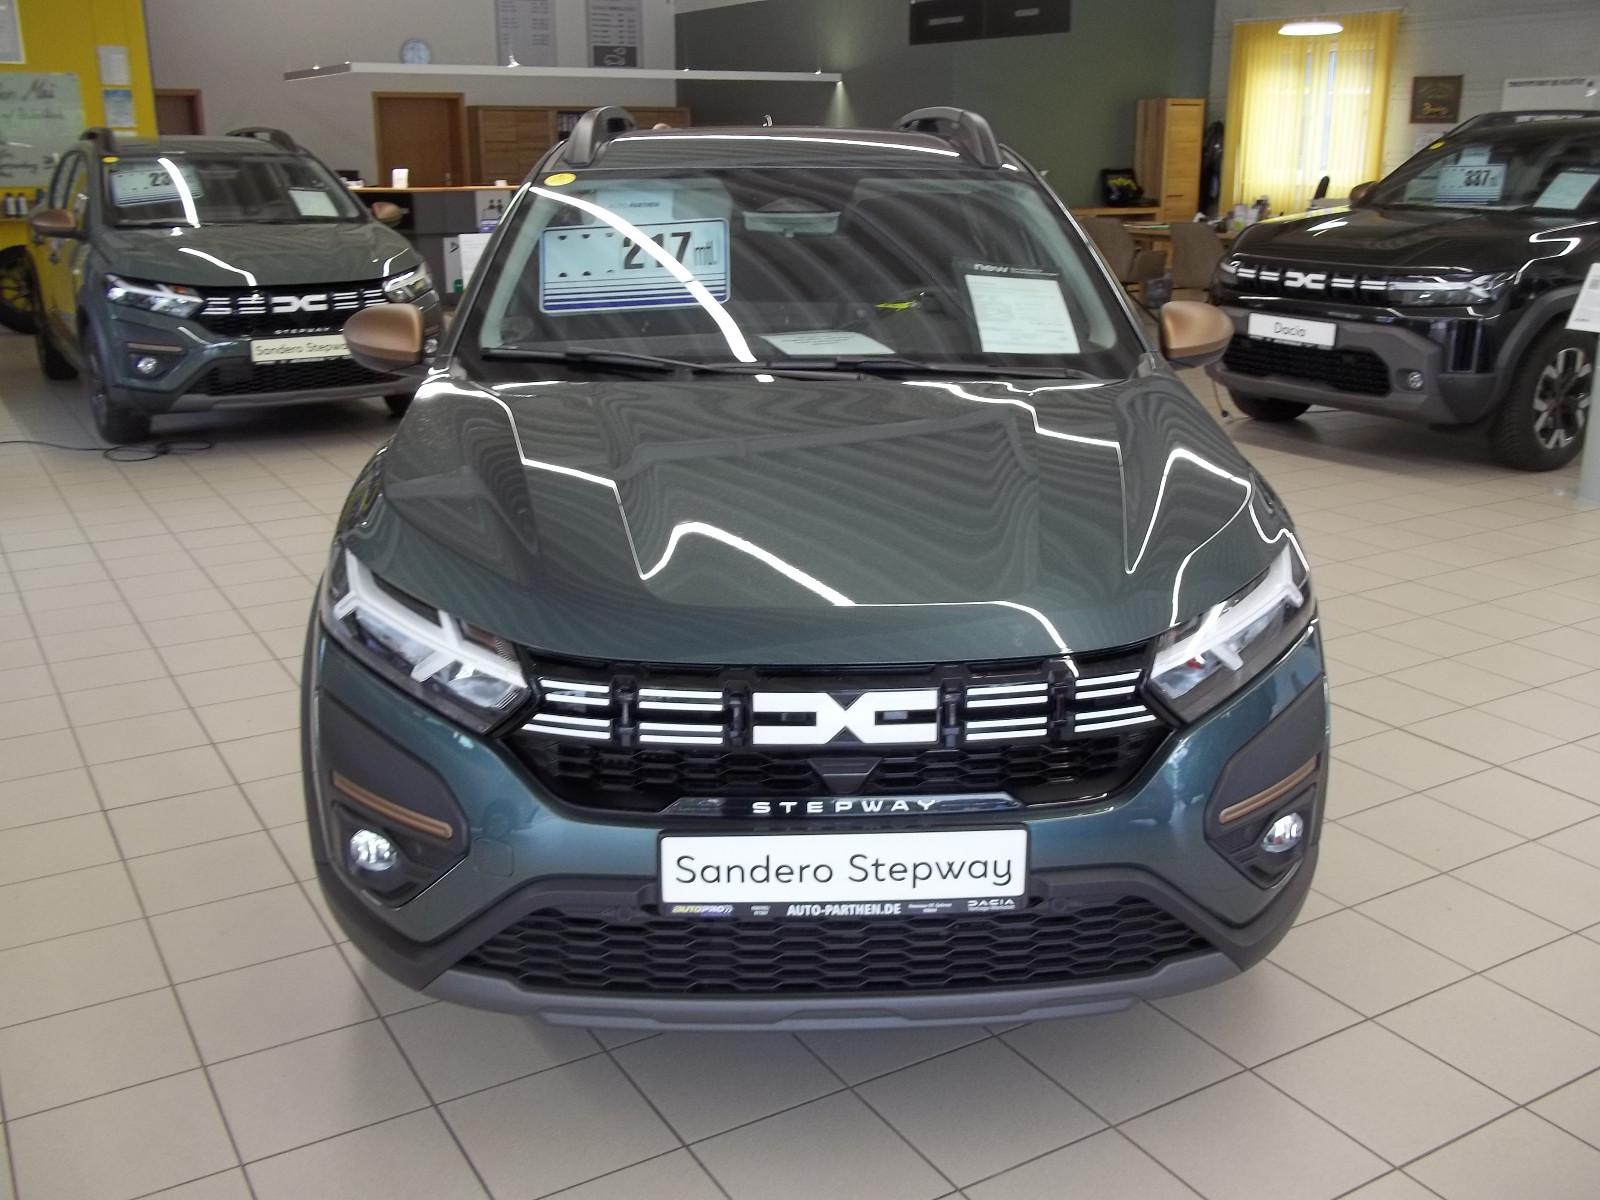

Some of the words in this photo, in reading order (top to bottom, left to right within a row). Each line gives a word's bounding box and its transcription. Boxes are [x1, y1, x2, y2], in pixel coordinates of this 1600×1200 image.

[622, 231, 692, 270] 217
[751, 798, 938, 815] STEPWAY
[675, 855, 834, 884] Sandero
[848, 854, 1013, 888] Stepway
[786, 903, 902, 918] AUTO-PARTHEN.DE
